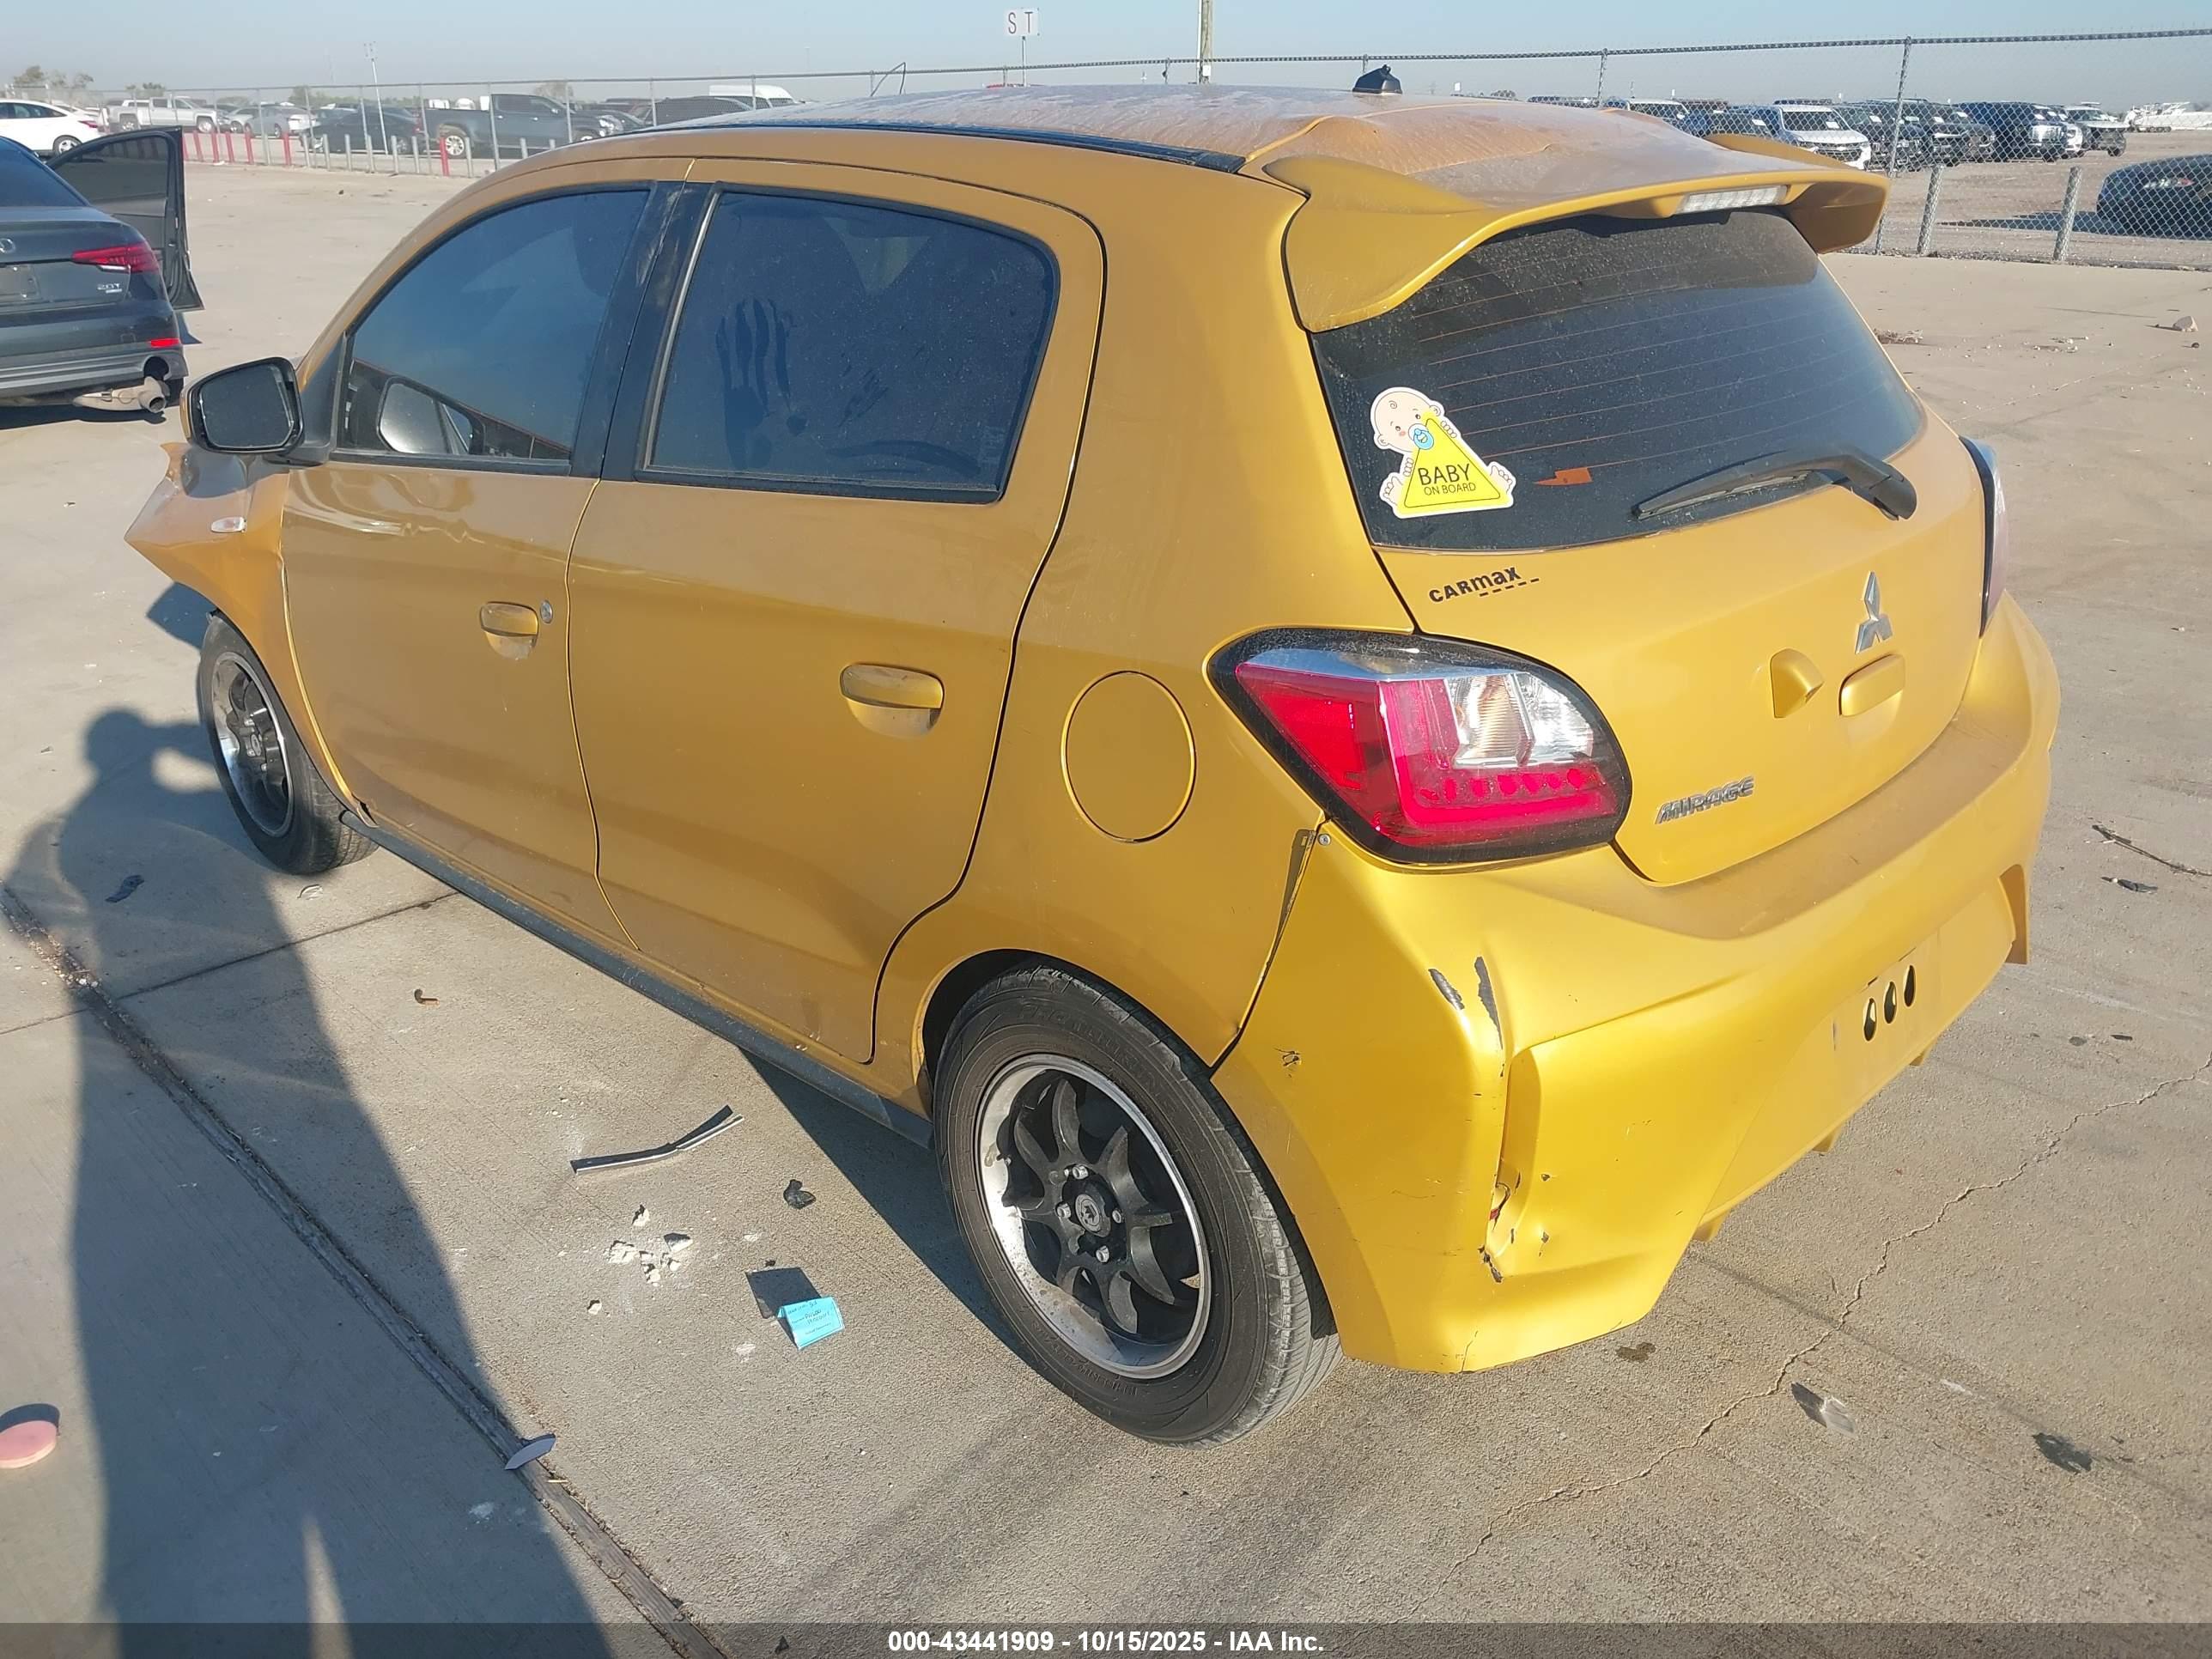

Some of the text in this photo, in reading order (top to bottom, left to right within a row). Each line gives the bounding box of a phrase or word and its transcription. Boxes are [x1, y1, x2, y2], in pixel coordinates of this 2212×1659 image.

[1418, 463, 1470, 486] BABY
[1424, 482, 1476, 495] ON BOARD
[1655, 775, 1754, 825] MIRAGE
